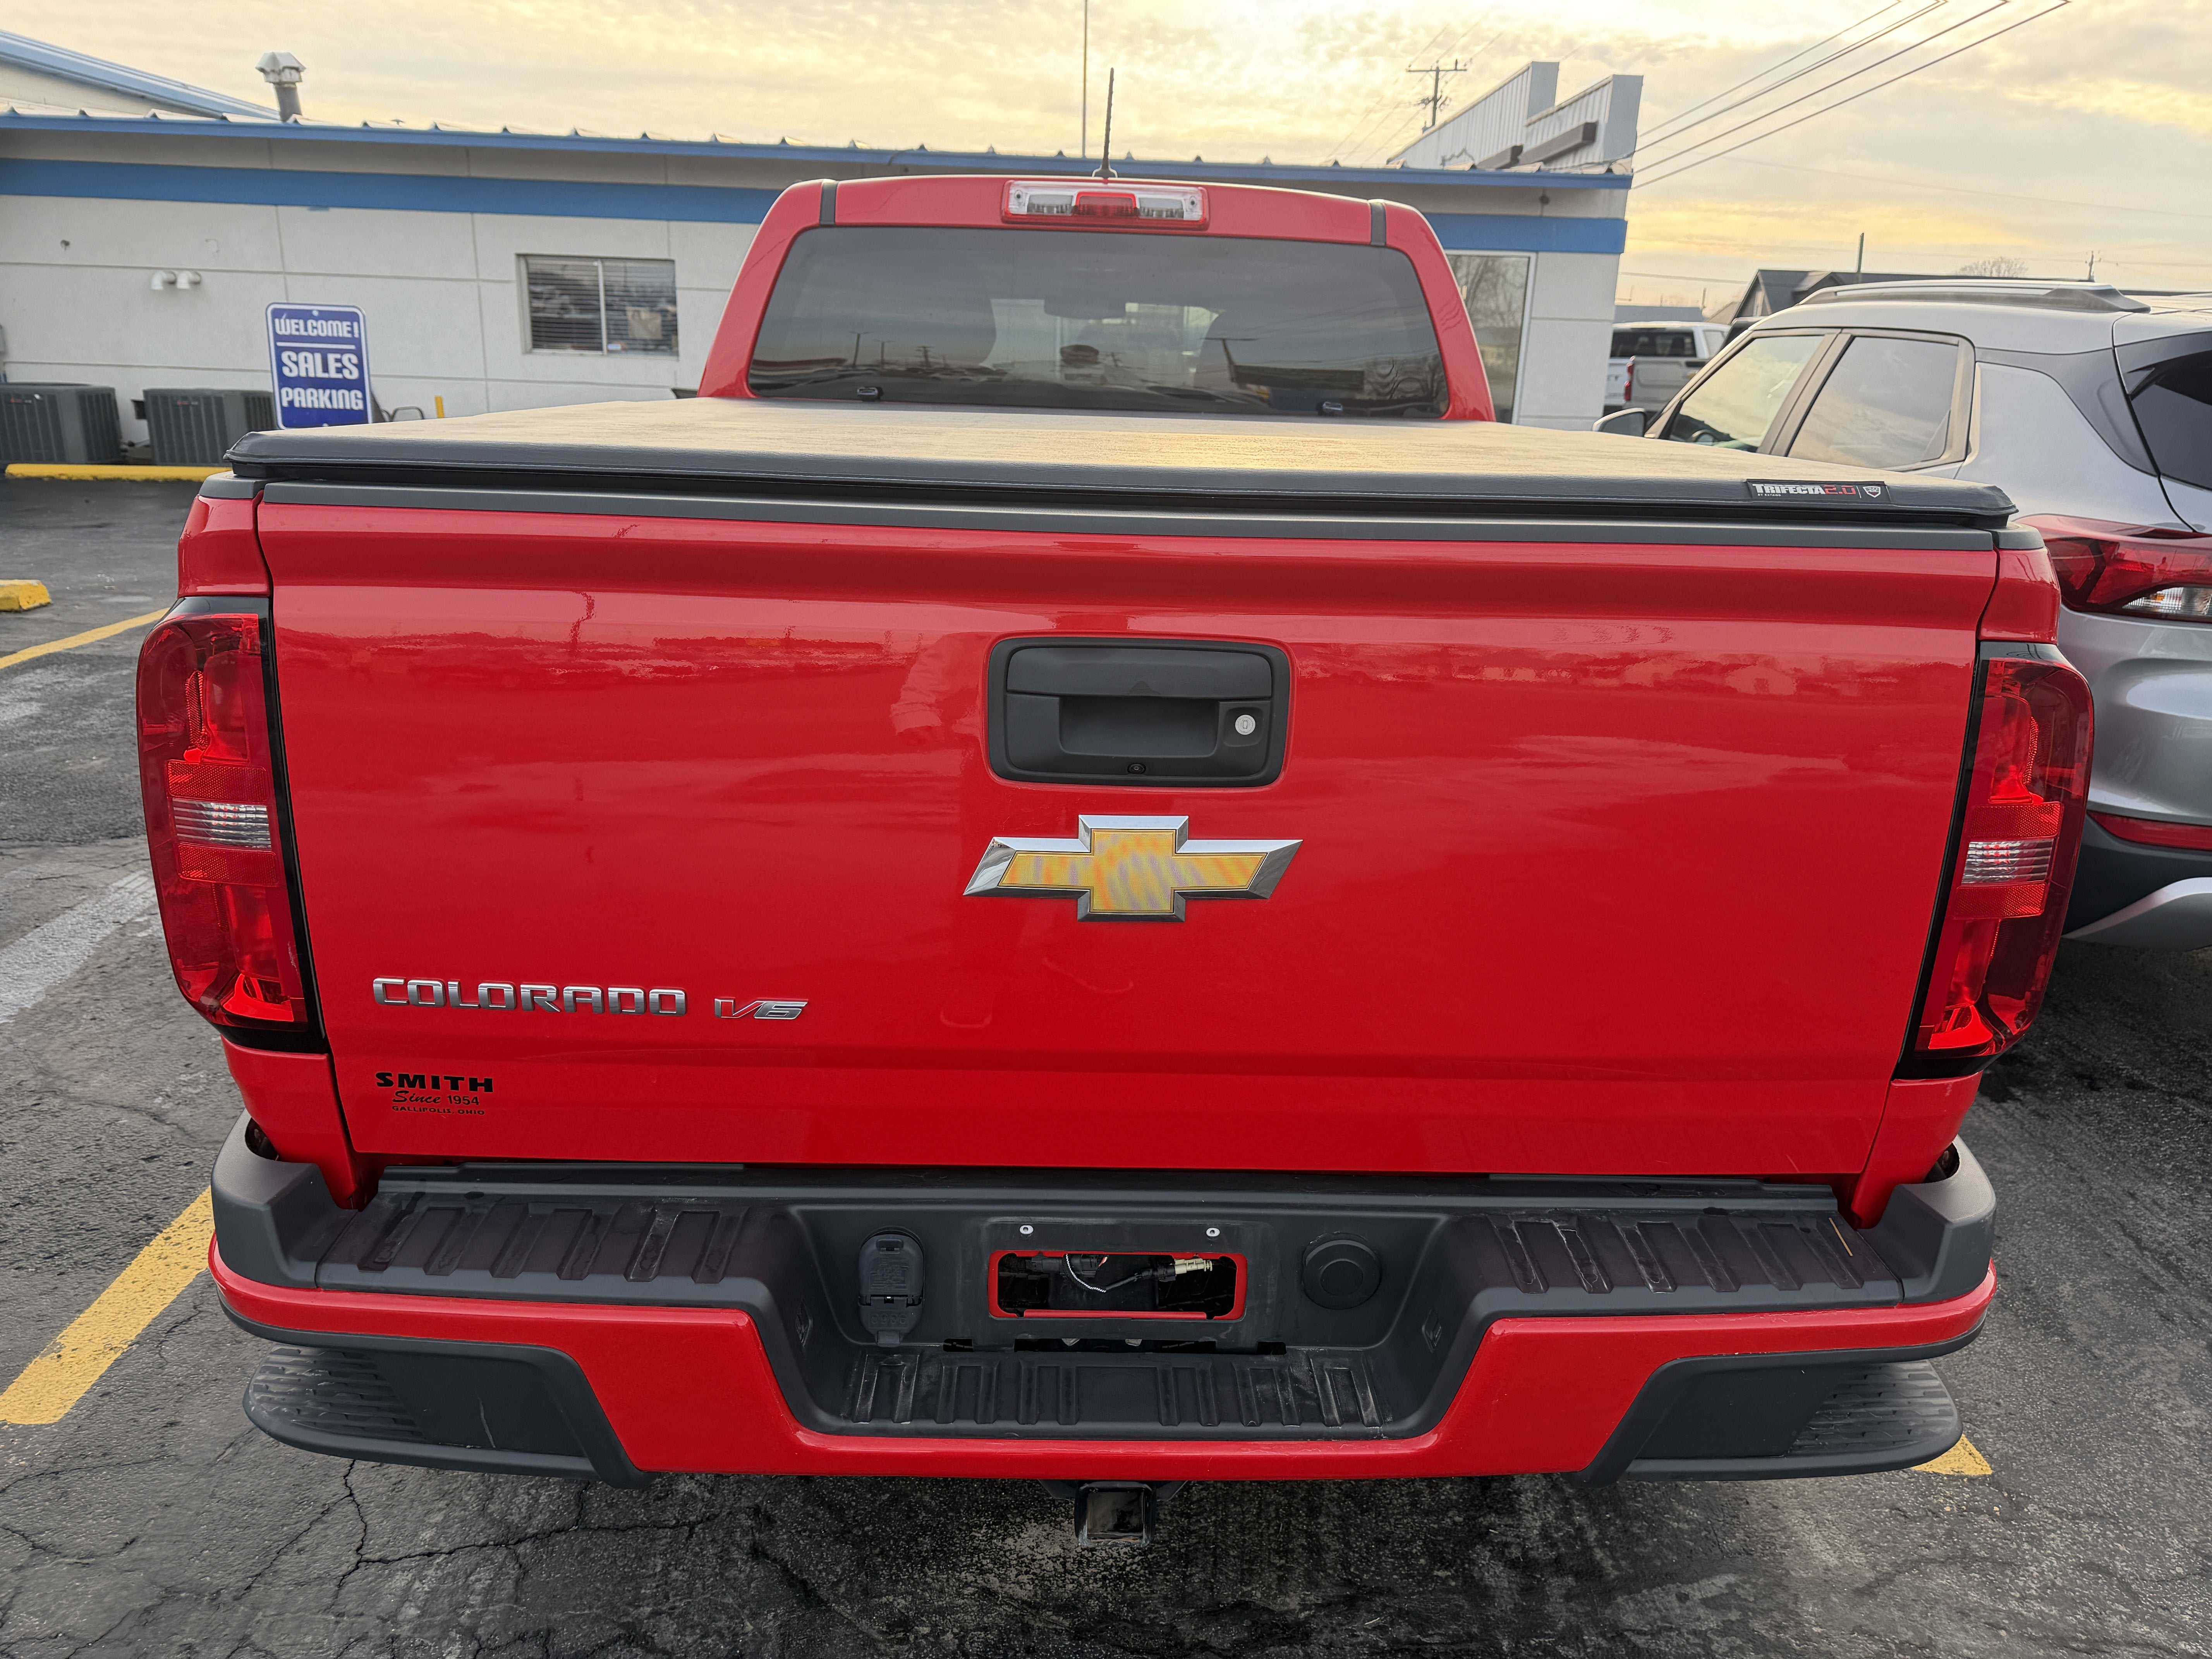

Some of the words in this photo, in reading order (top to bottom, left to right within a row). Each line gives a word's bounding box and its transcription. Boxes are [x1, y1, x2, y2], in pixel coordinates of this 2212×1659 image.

[275, 318, 360, 338] WELCOME!
[281, 350, 359, 380] SALES
[281, 387, 364, 410] PARKING
[1752, 484, 1826, 495] TRIFECTA
[372, 977, 687, 1017] COLORADO
[714, 998, 809, 1020] V6
[375, 1072, 494, 1093] SMITH
[392, 1090, 441, 1104] Since
[447, 1095, 480, 1106] 1954
